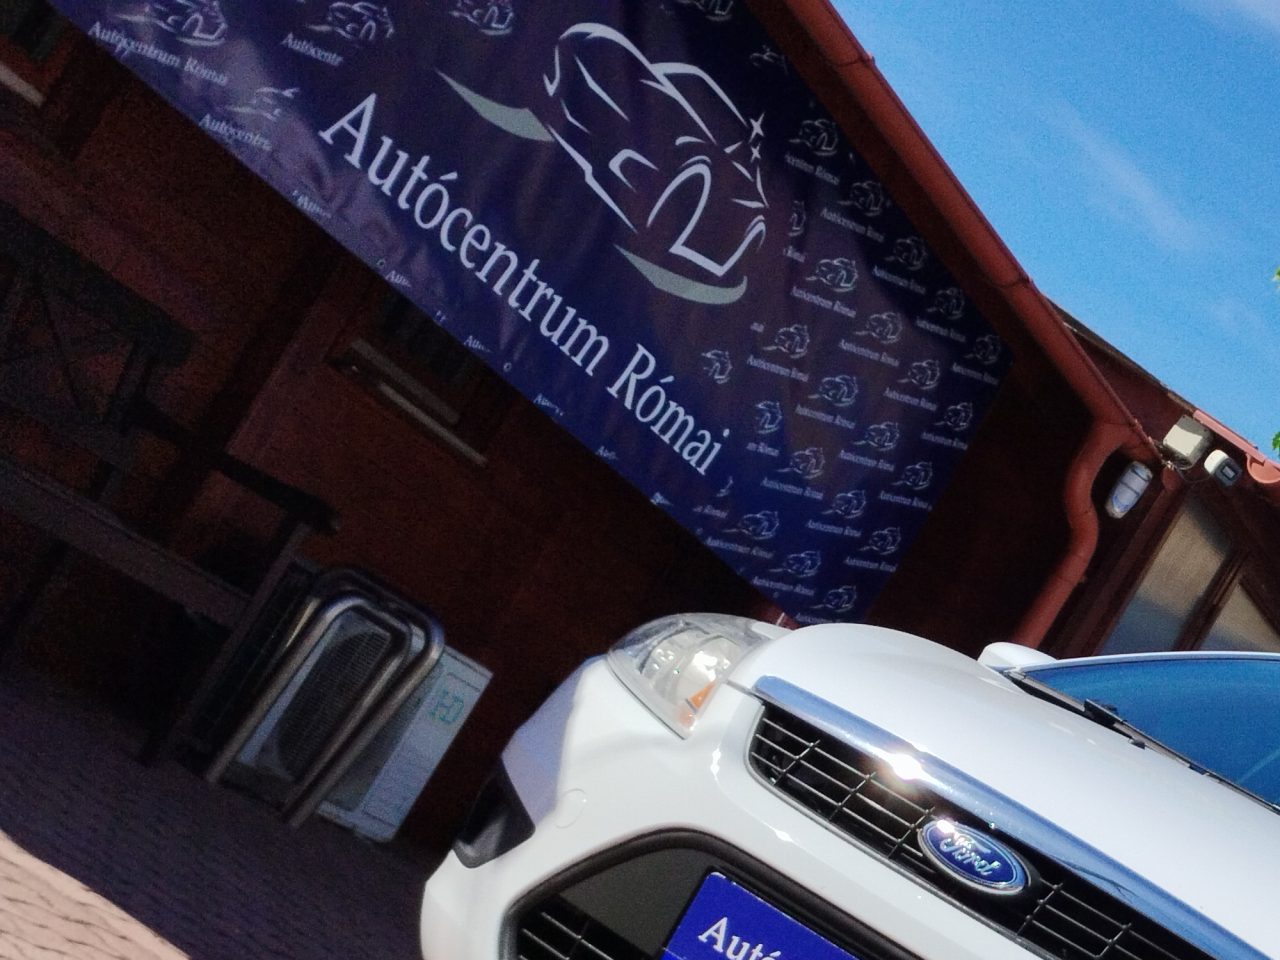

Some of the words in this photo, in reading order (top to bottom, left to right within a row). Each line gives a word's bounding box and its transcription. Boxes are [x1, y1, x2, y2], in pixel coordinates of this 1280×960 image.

[318, 92, 611, 377] Autócentrum
[606, 343, 731, 476] Római
[939, 831, 1001, 876] Ford
